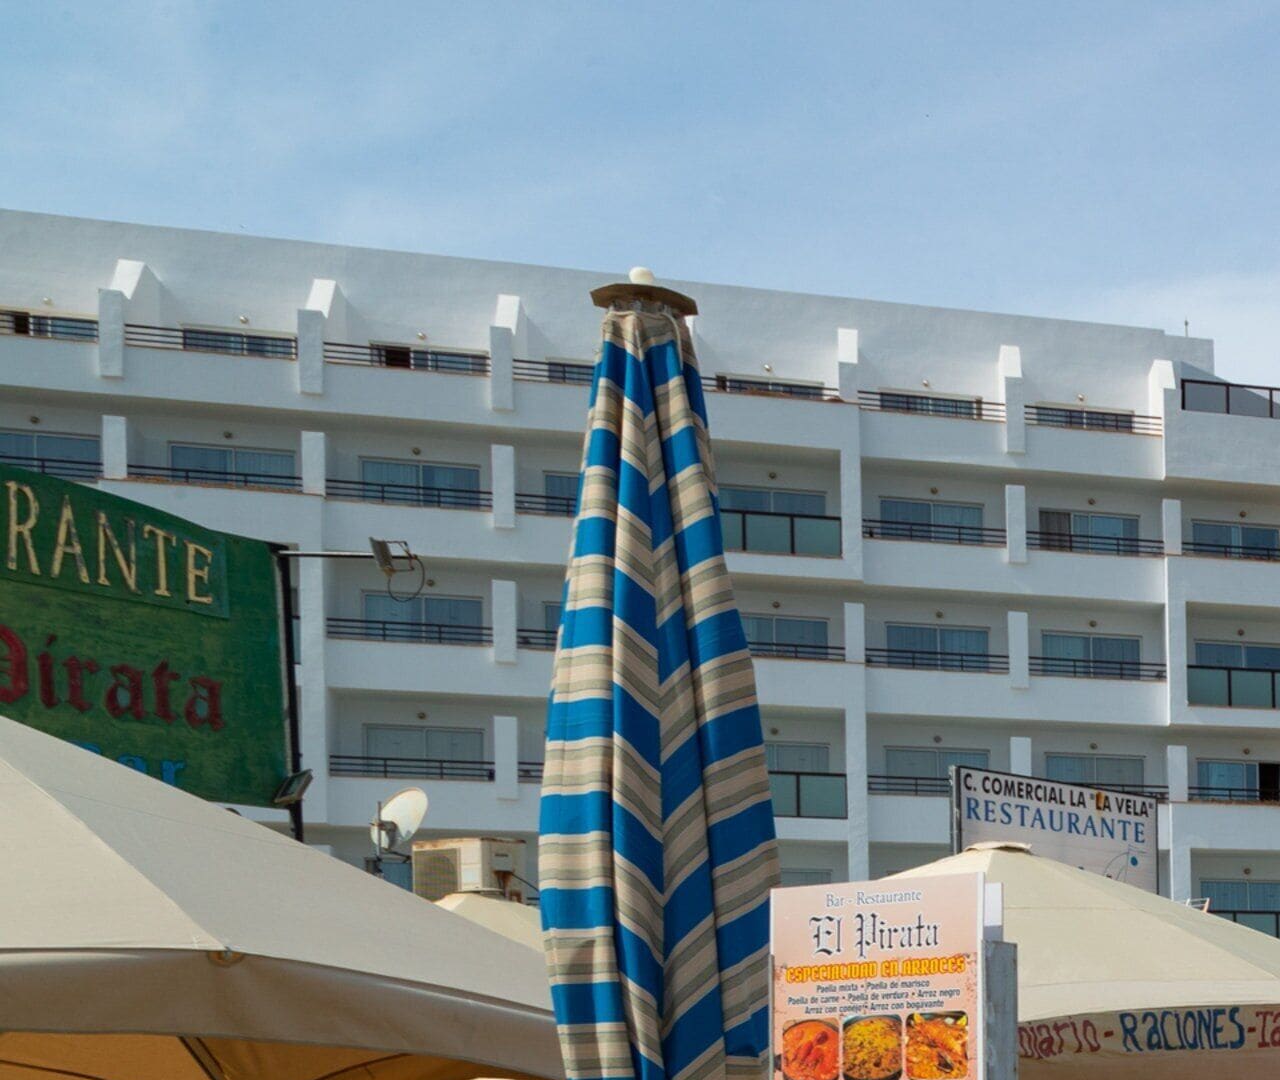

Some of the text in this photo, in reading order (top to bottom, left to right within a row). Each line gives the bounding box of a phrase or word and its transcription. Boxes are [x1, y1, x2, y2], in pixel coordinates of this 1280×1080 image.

[964, 773, 976, 791] C.
[982, 776, 1065, 805] COMERCIAL
[1070, 790, 1086, 808] LA
[966, 797, 1145, 843] RESTAURANTE
[826, 890, 922, 907] Bar Restaurante
[810, 913, 939, 958] El Pirata
[786, 956, 966, 983] ESPECIALIDAD EN ARROCES
[788, 997, 808, 1005] Paella
[809, 996, 819, 1004] de
[848, 993, 868, 1001] Paella
[871, 992, 880, 1000] de
[882, 990, 909, 999] verdura
[918, 989, 937, 997] Arroz
[939, 988, 960, 998] negro
[816, 979, 930, 993] Paella mixta Paella de marisco
[906, 1000, 944, 1011] bogavante
